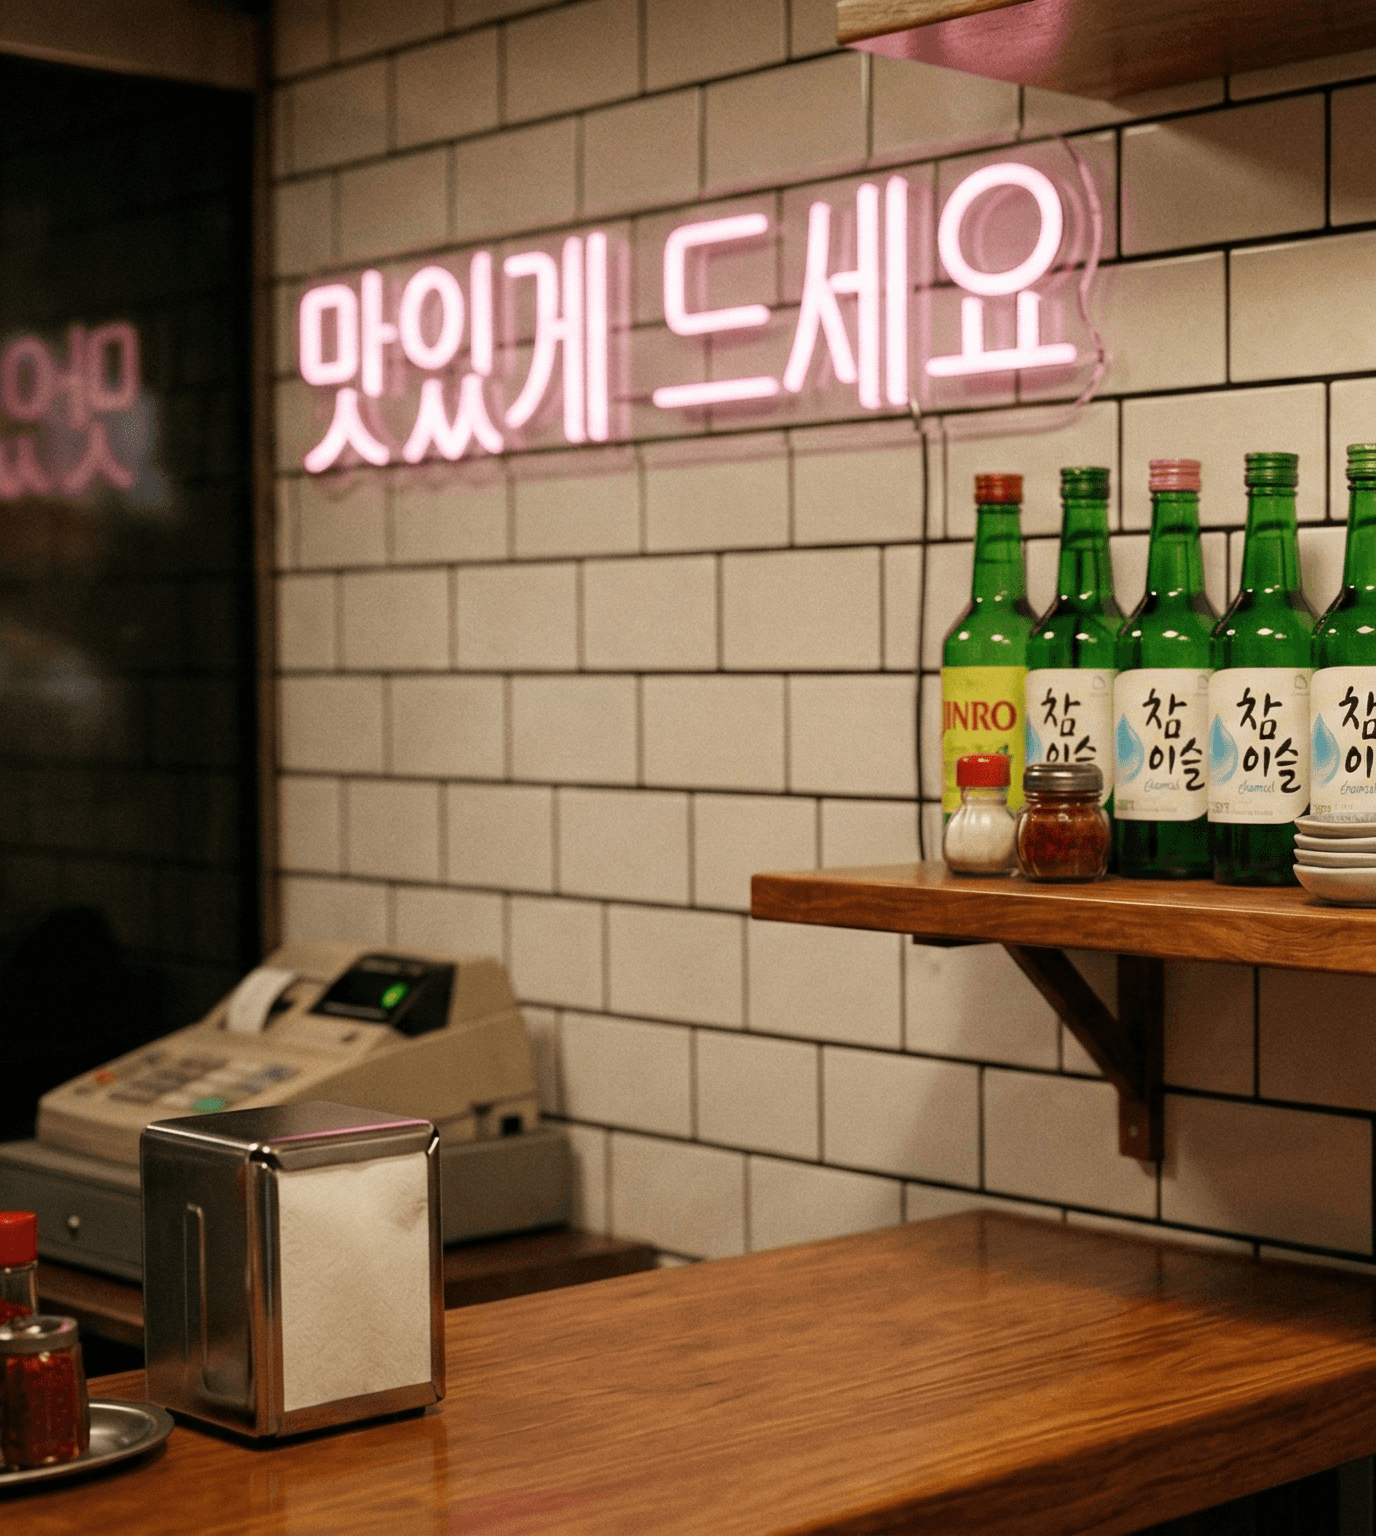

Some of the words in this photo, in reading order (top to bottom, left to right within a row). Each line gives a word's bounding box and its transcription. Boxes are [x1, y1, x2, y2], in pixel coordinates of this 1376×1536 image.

[298, 229, 610, 475] 맛있게
[652, 162, 1078, 410] 드세요
[1041, 687, 1082, 738] 참
[1142, 687, 1188, 740] 참
[1236, 686, 1284, 741] 참
[1148, 736, 1206, 792] 이슬
[1242, 736, 1302, 794] 이슬
